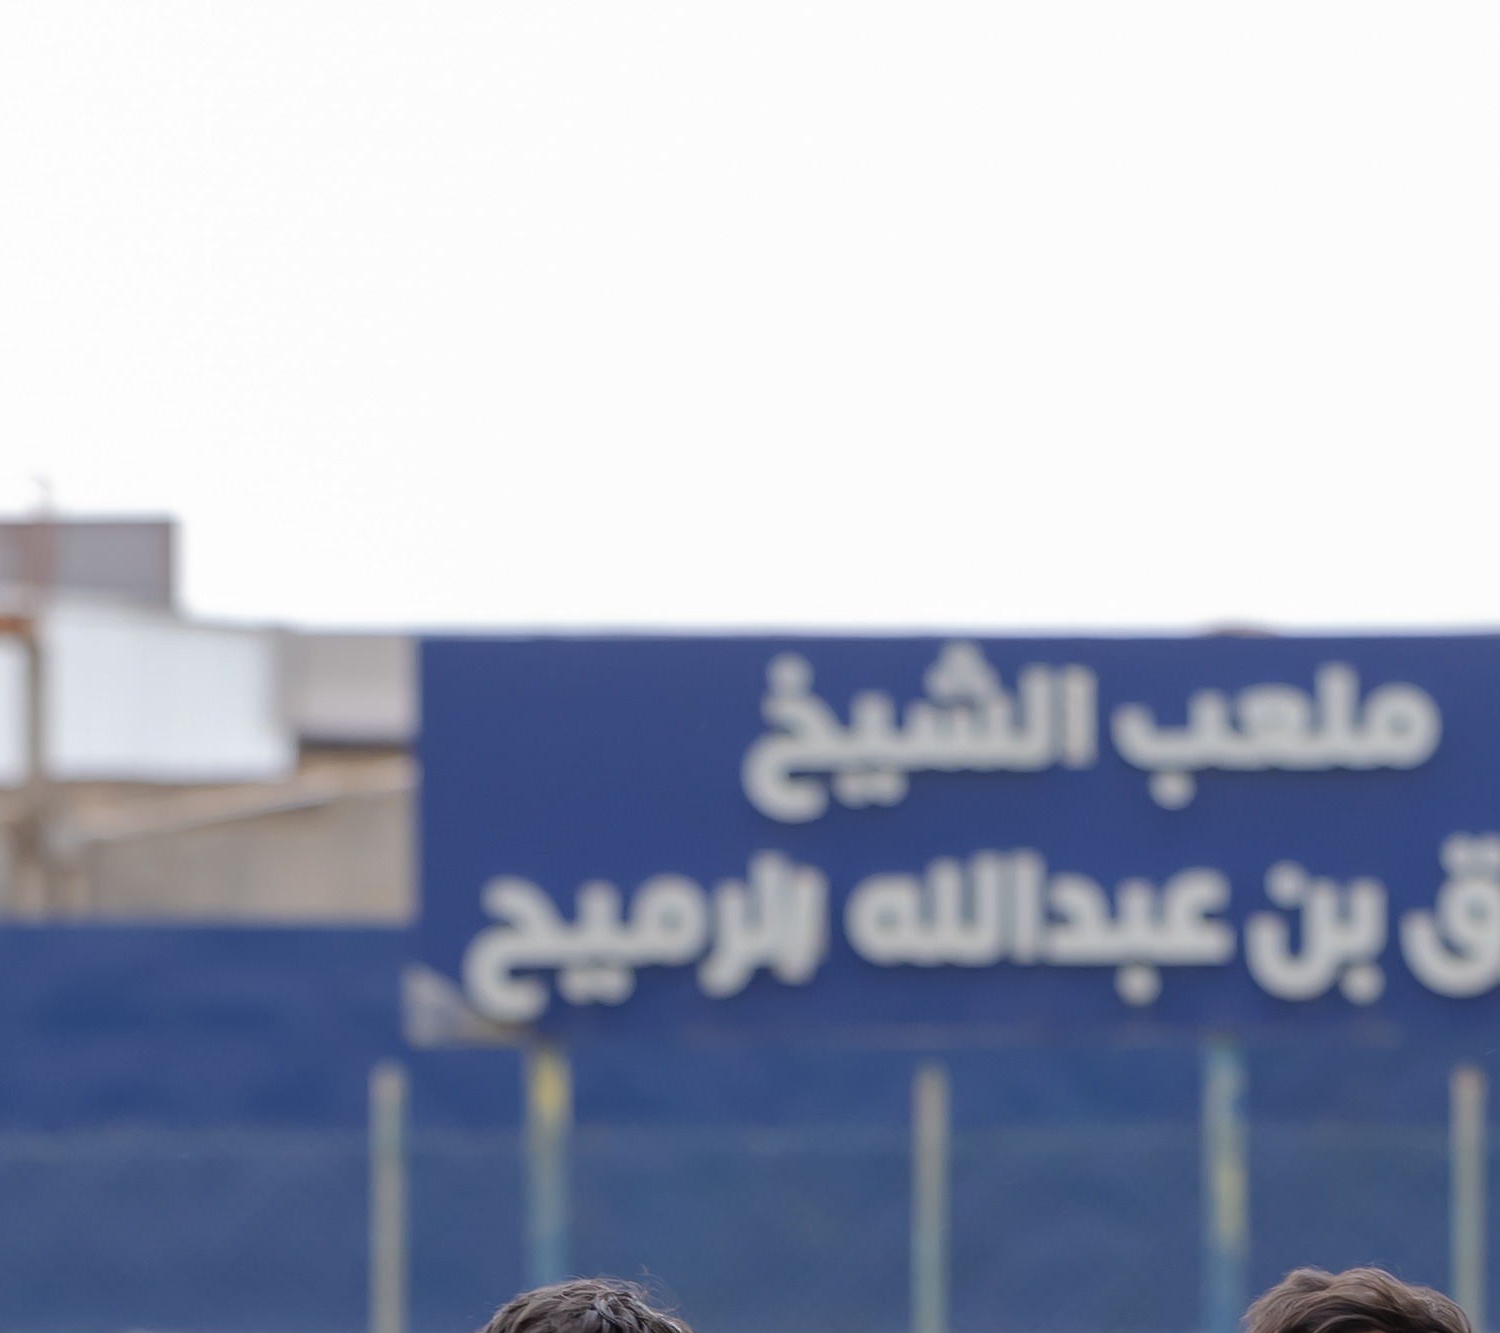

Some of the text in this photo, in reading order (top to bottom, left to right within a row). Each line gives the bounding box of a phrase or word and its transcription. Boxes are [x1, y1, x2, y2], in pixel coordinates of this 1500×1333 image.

[740, 640, 1443, 824] ملعب الشيخ
[845, 849, 1237, 1006] عبدالله
[1245, 860, 1389, 1005] بن
